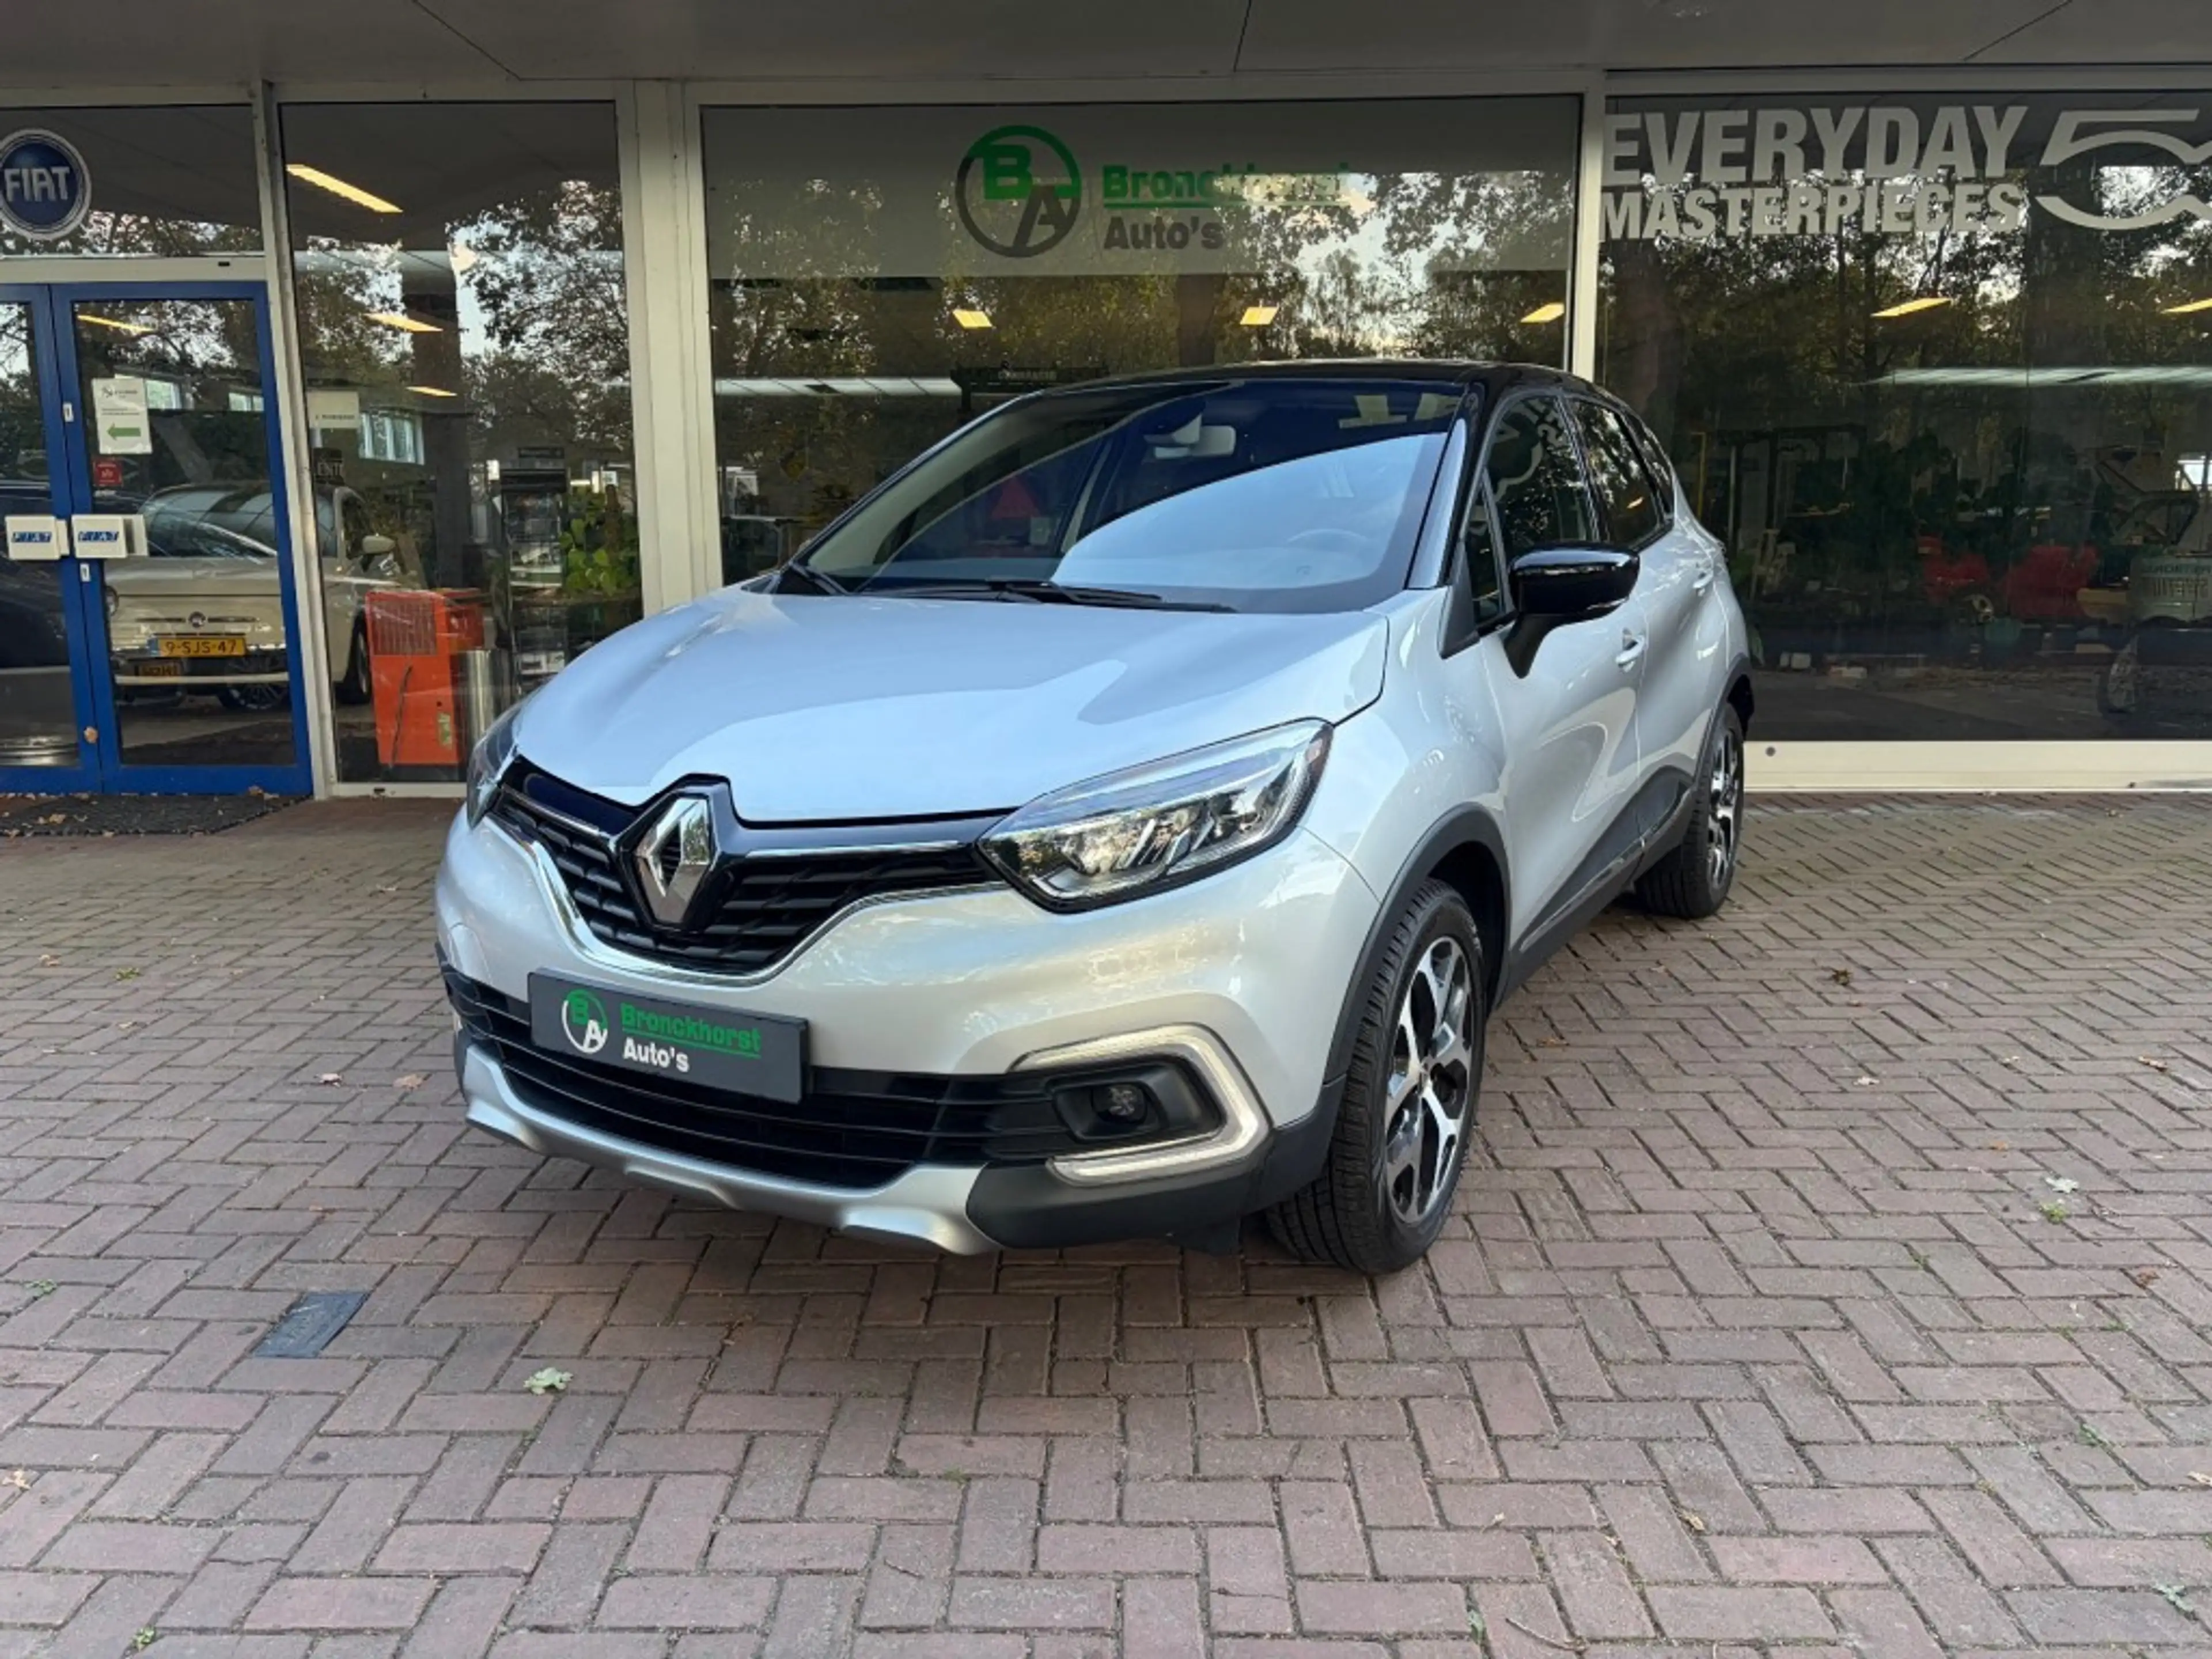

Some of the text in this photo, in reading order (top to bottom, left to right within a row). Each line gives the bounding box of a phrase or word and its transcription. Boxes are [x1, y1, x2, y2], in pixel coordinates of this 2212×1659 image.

[1603, 106, 2029, 186] EVERYDAY
[4, 166, 70, 202] FIAT
[1599, 183, 2025, 240] MASTERPIECES
[1103, 215, 1225, 250] Auto's
[13, 531, 52, 543] FIAT
[78, 531, 119, 542] FIAT
[165, 640, 237, 654] 9-SJS-47
[620, 1002, 762, 1052] Bronckhorst
[623, 1036, 691, 1073] Auto's
